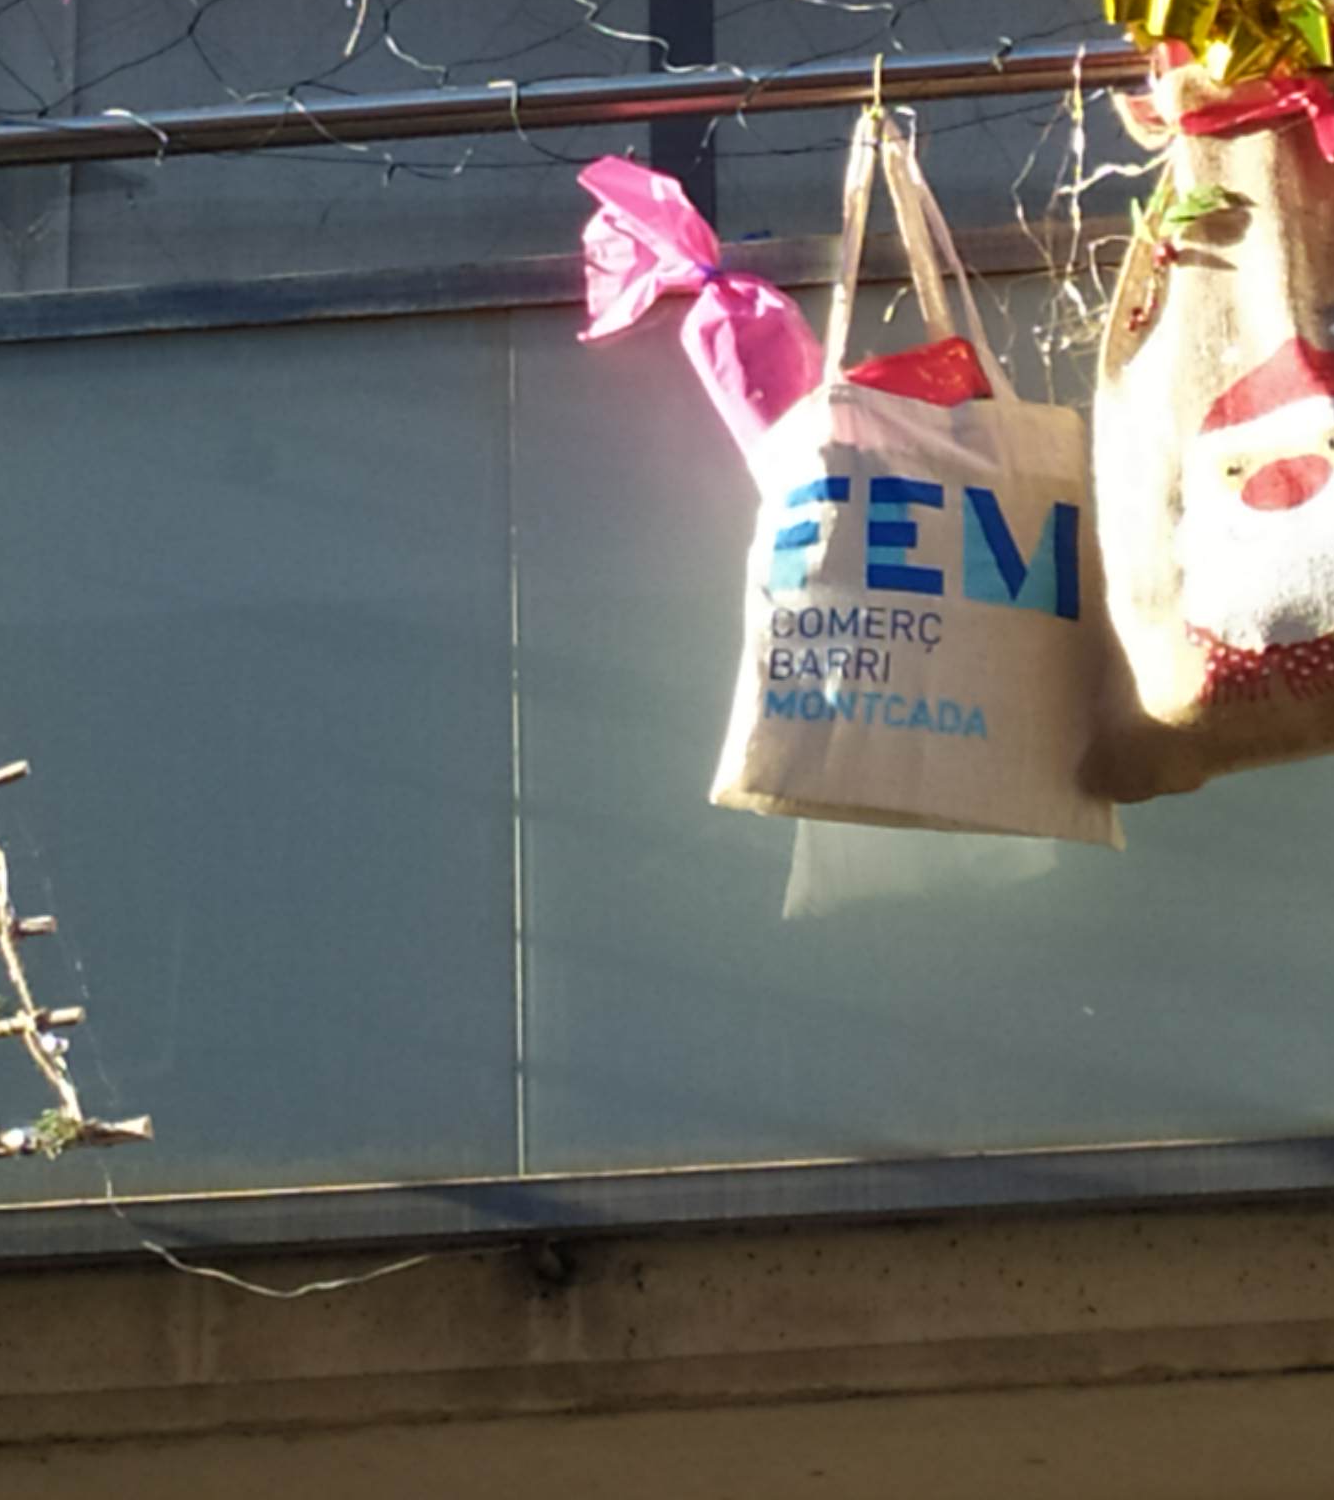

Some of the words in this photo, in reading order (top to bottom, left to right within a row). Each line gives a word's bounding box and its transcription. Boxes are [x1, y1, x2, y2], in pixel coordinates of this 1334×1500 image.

[769, 476, 1079, 621] FEM
[771, 606, 943, 653] COMERÇ
[769, 648, 891, 683] BARRI
[763, 688, 988, 740] MONTCADA
